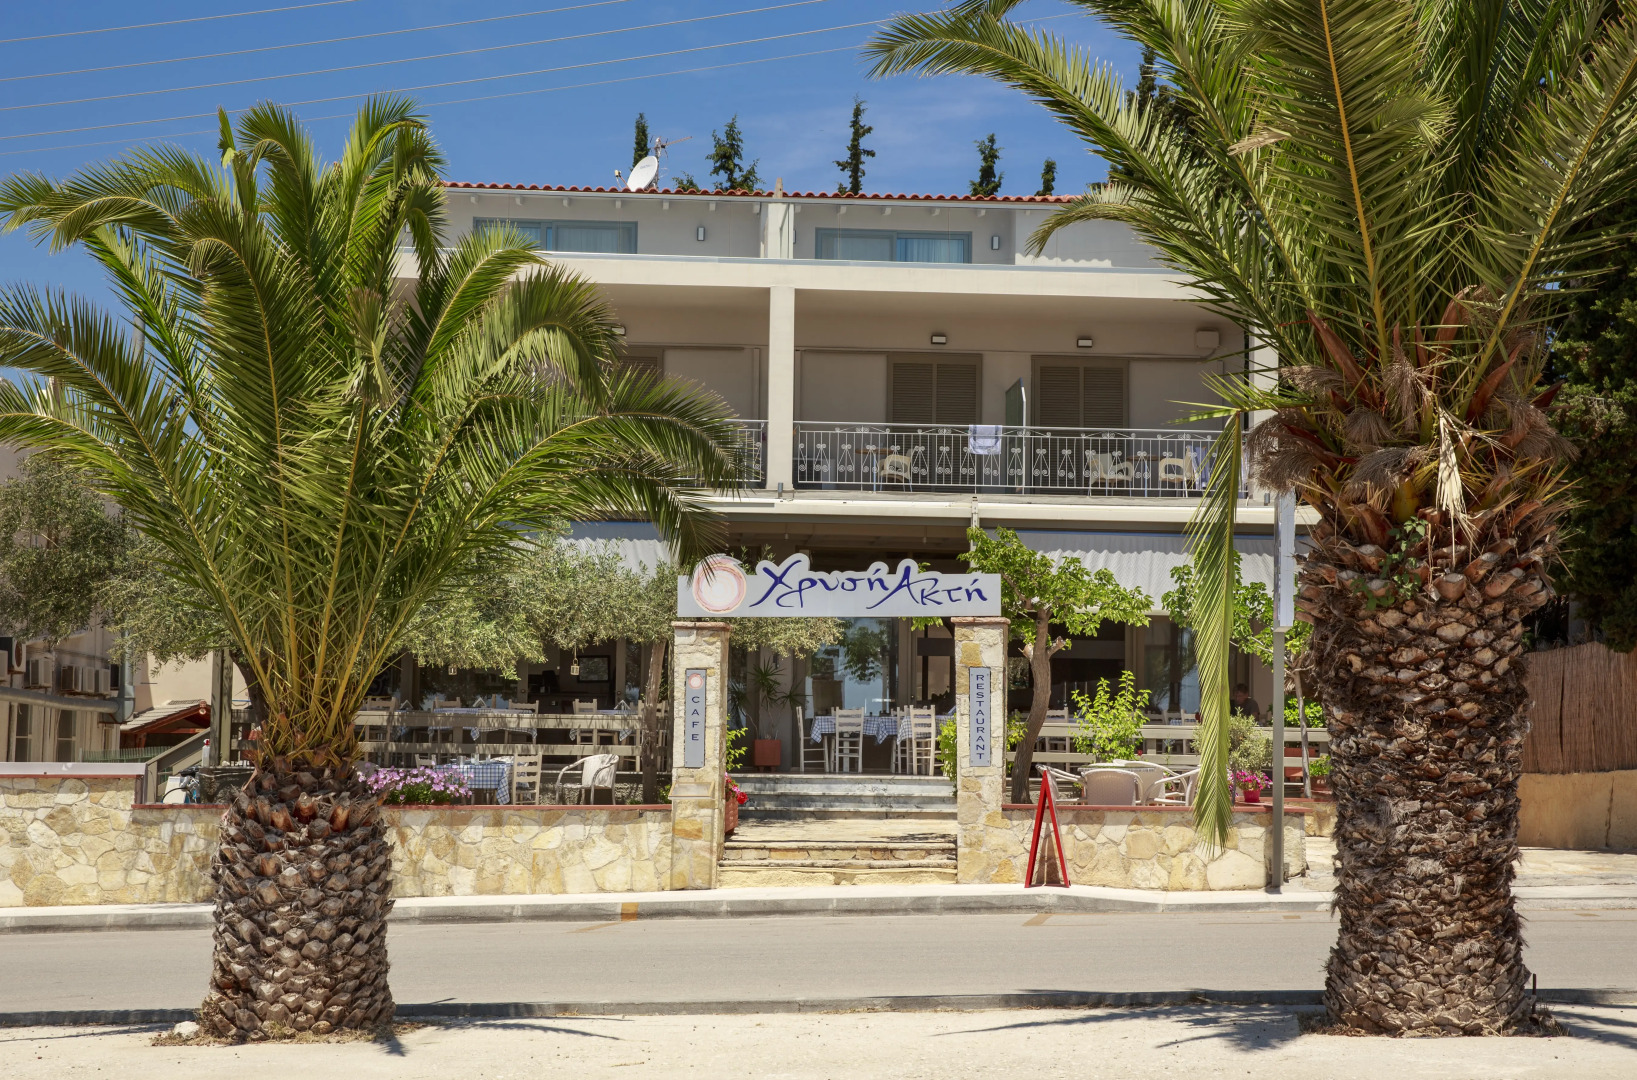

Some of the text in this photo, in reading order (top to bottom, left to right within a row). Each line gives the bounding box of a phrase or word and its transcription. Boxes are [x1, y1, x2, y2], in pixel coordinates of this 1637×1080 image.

[750, 559, 988, 609] Χρυσή Ακτή
[691, 696, 700, 741] CAFE
[975, 674, 985, 760] RESTAURANT
